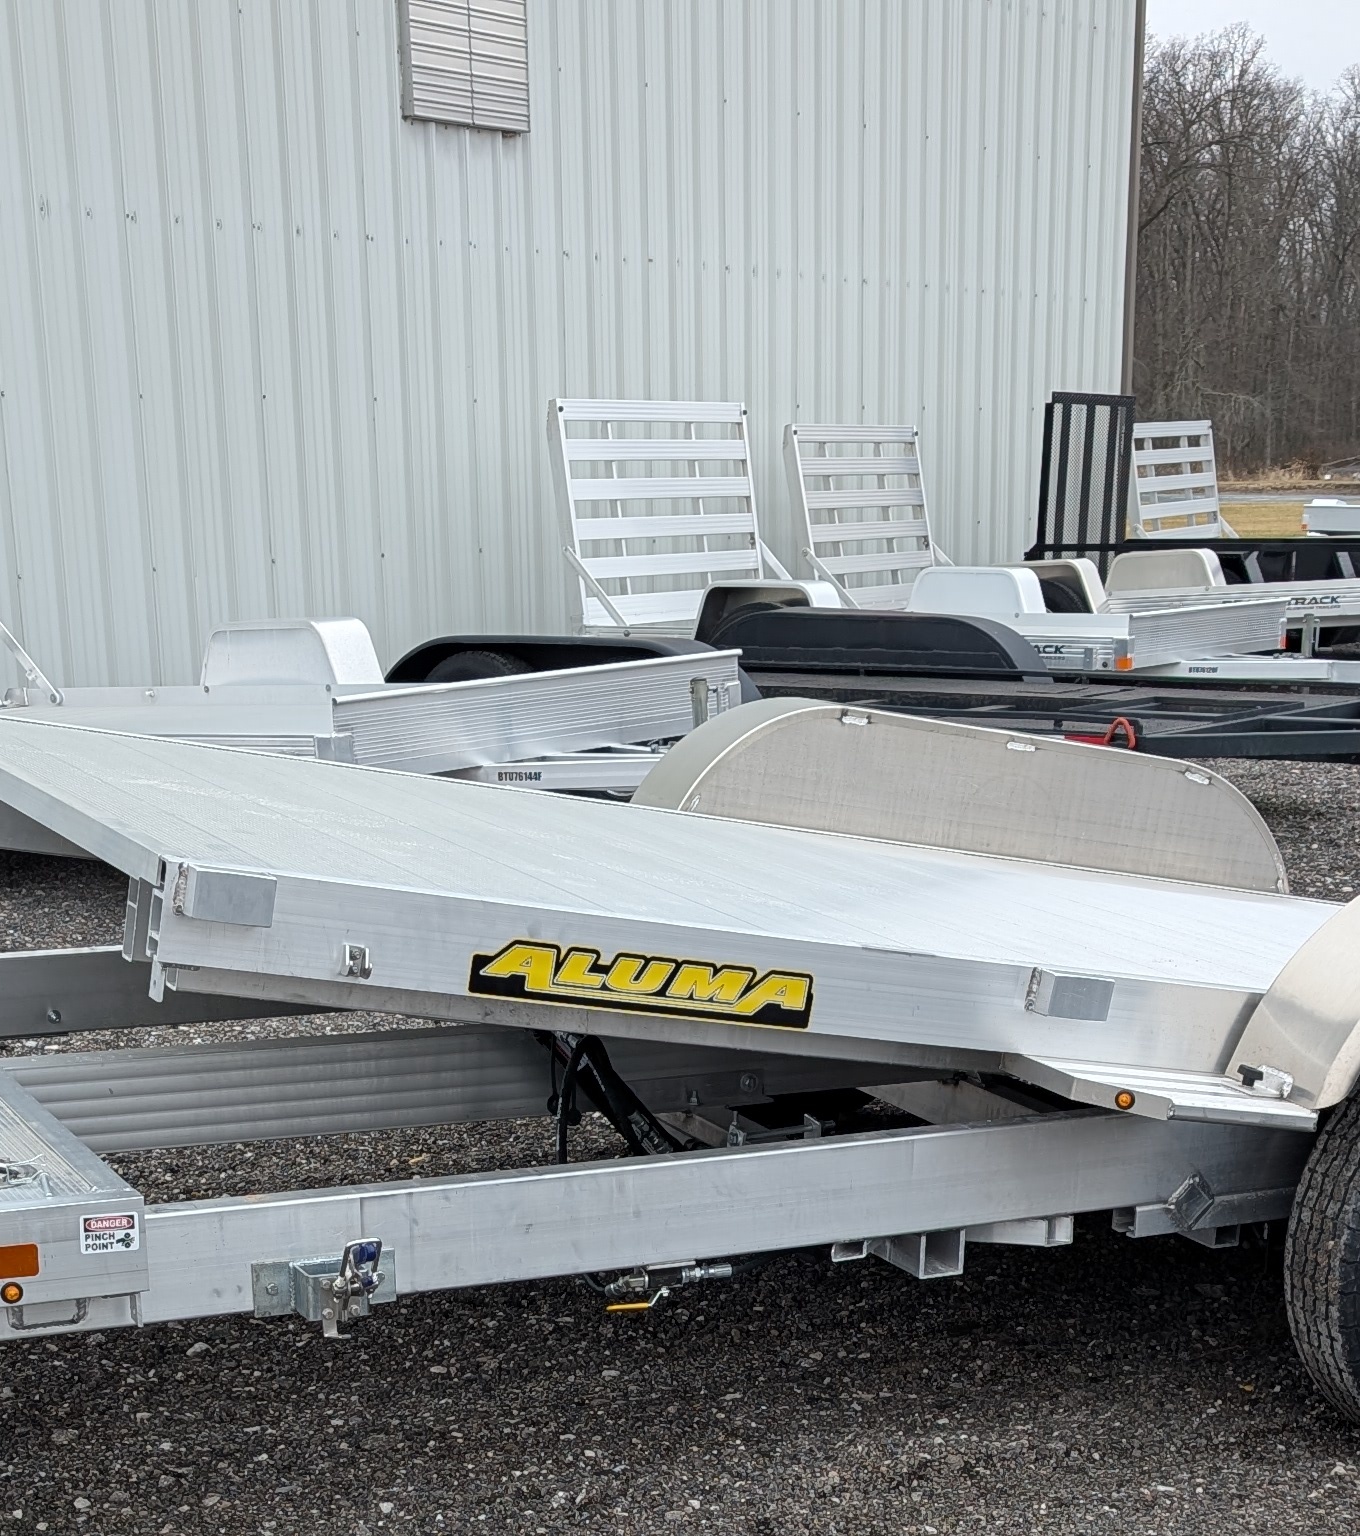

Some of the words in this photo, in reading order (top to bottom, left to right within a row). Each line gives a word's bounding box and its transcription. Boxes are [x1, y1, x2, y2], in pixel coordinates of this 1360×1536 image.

[497, 771, 543, 781] BTU76144F
[479, 945, 809, 1017] ALUMA
[90, 1219, 128, 1229] DANGER
[85, 1232, 115, 1242] PINCH
[85, 1242, 115, 1252] POINT
